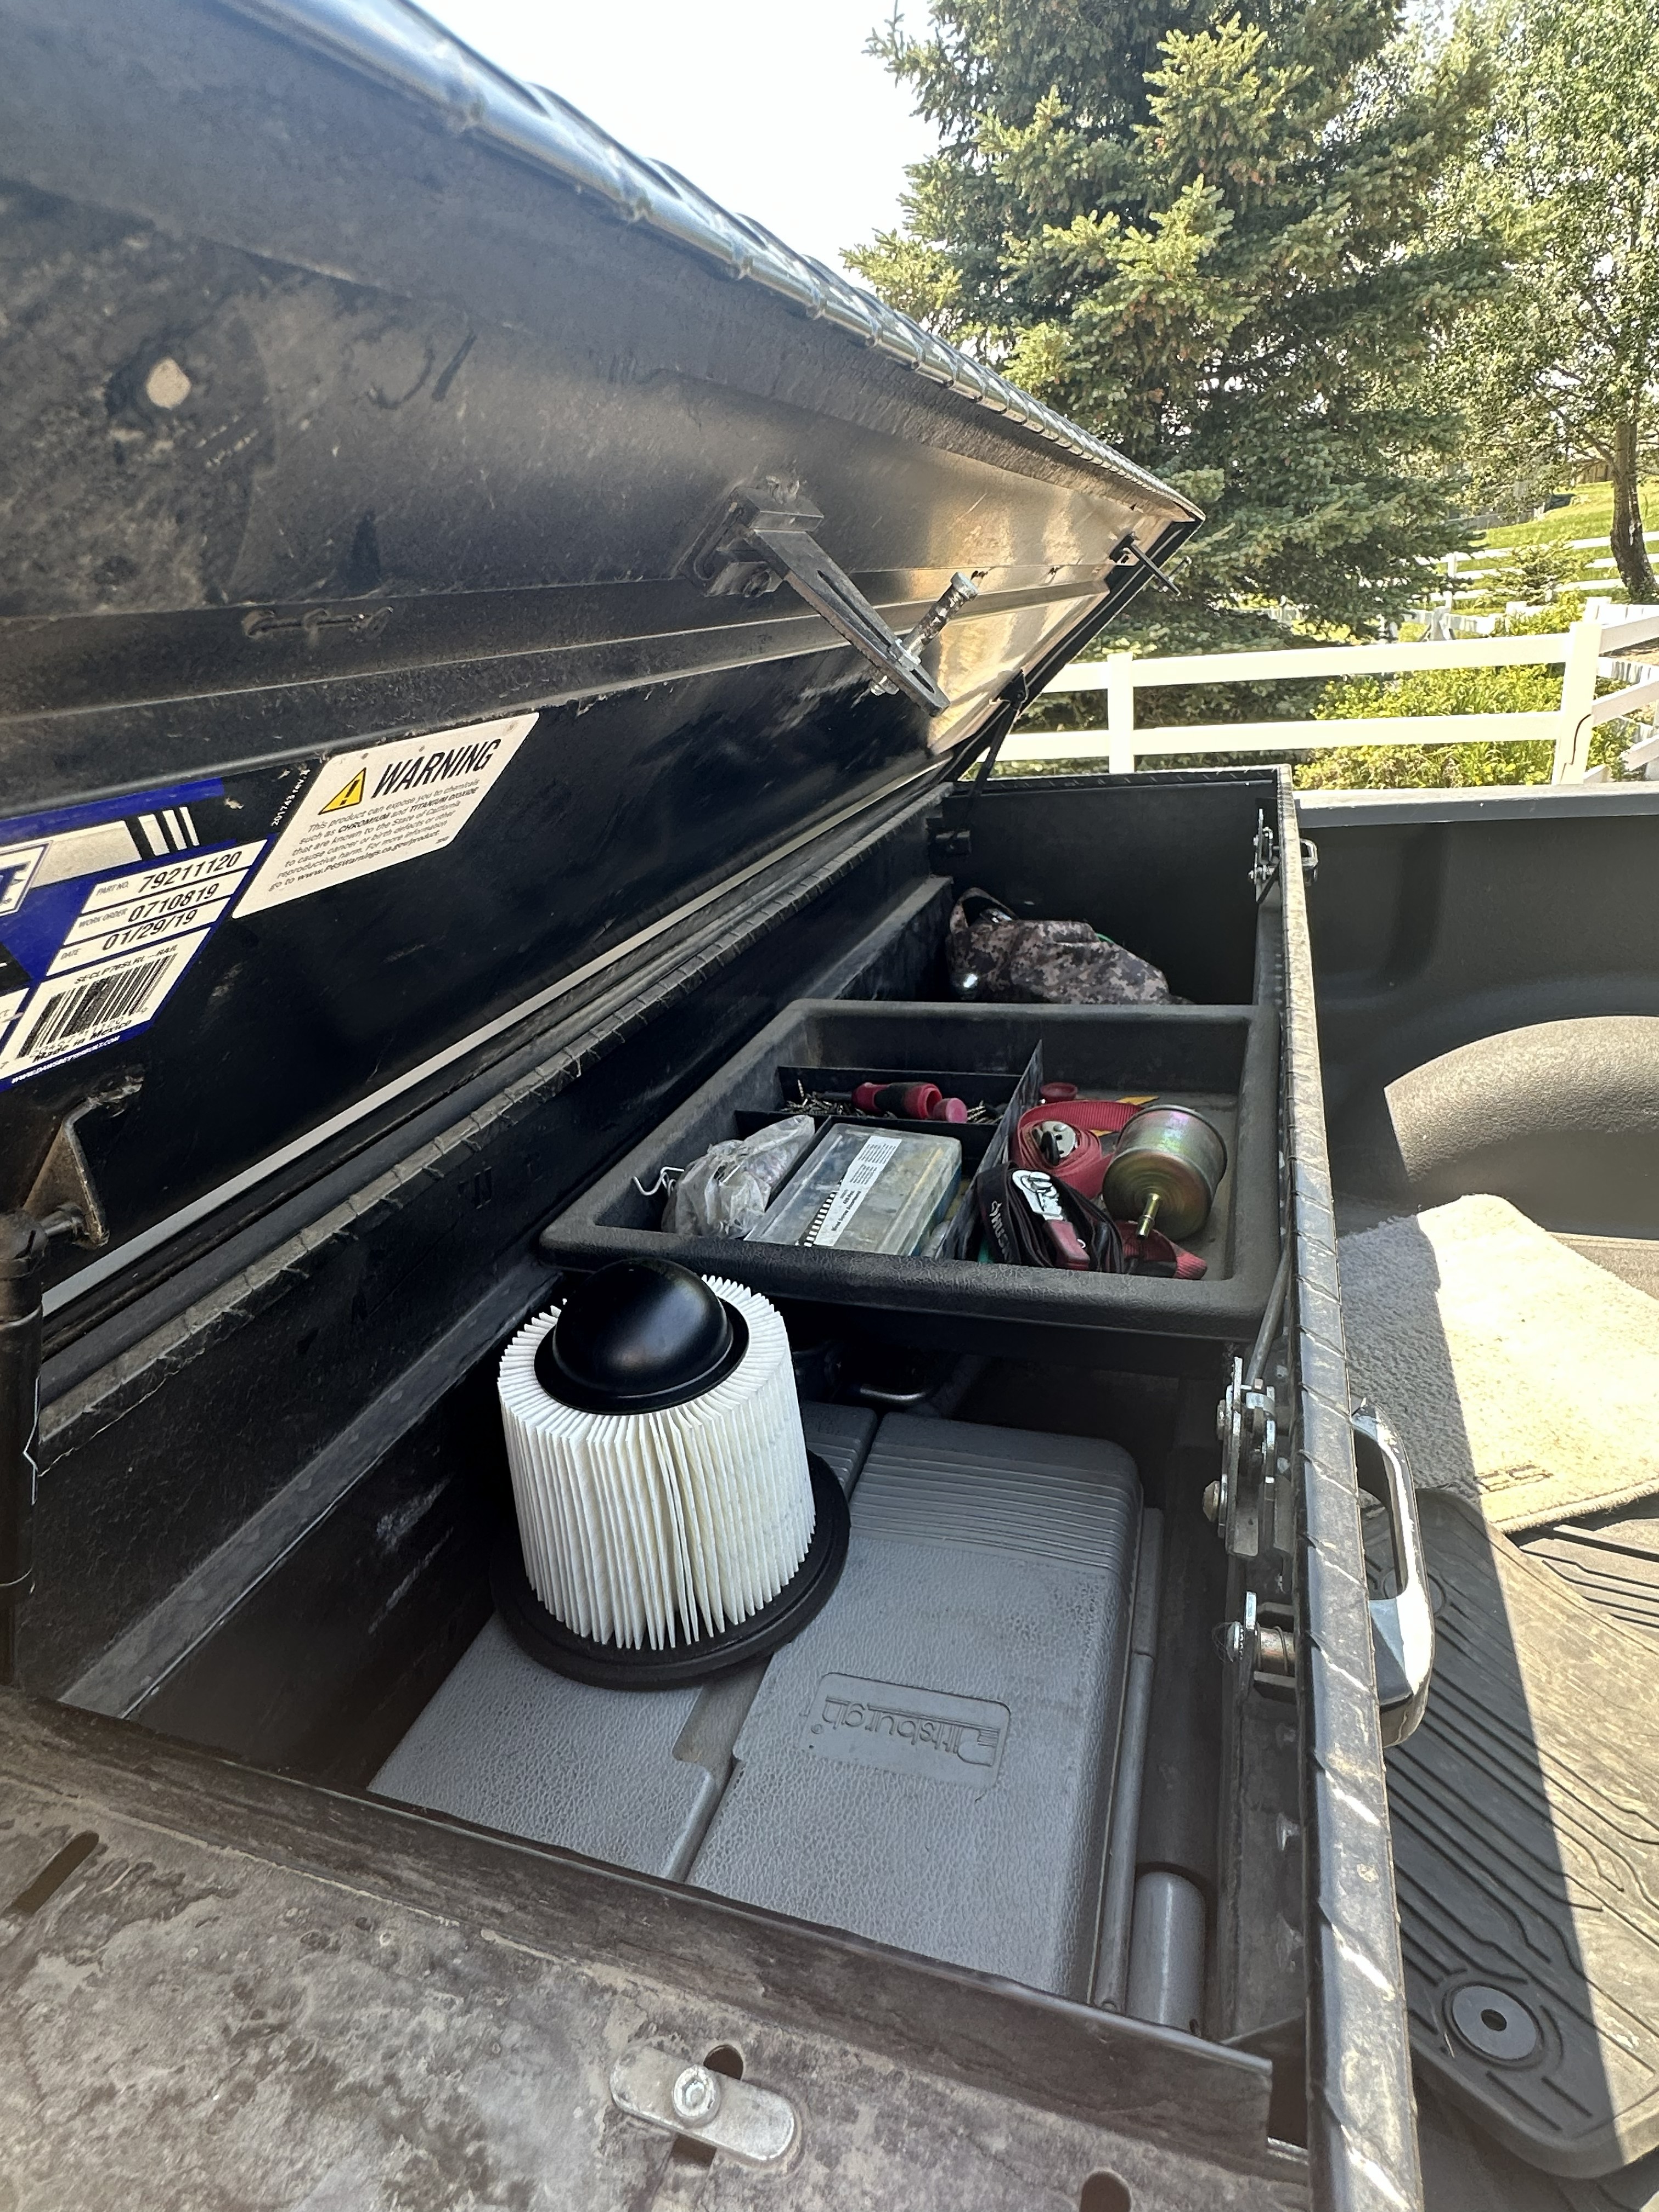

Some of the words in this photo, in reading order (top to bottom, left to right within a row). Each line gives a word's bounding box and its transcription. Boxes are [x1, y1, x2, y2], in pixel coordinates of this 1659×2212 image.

[371, 739, 501, 799] WARNING
[292, 845, 313, 856] that
[313, 840, 330, 850] are
[331, 831, 362, 844] known
[376, 822, 391, 831] the
[392, 815, 415, 826] State
[415, 810, 427, 819] of
[426, 800, 461, 816] California
[299, 832, 323, 844] such
[324, 829, 336, 838] as
[338, 812, 391, 833] CHROMIUM
[391, 807, 409, 818] and
[410, 796, 448, 812] TITANIUM
[308, 821, 328, 832] This
[328, 811, 366, 828] product
[368, 806, 385, 815] can
[386, 798, 415, 810] expose
[415, 792, 432, 804] you
[444, 779, 480, 794] chemicals
[277, 856, 336, 879] reproductive
[365, 842, 381, 851] For
[381, 834, 403, 845] more
[404, 820, 447, 838] information
[297, 851, 325, 864] cause
[327, 840, 359, 854] cancer
[371, 829, 392, 840] birth
[393, 820, 424, 833] defects
[435, 810, 456, 821] other
[96, 884, 117, 896] PART
[138, 851, 242, 893] 79211120
[268, 882, 283, 891] go
[78, 916, 103, 928] WORK
[103, 908, 128, 921] ORDER
[128, 883, 219, 922] 0710819
[60, 949, 81, 960] DATE
[103, 909, 198, 950] 01/29/19
[32, 1046, 63, 1063] Made
[73, 1038, 85, 1047] in
[89, 1020, 132, 1040] Mexico
[822, 1699, 1001, 1767] Pittsburgh
